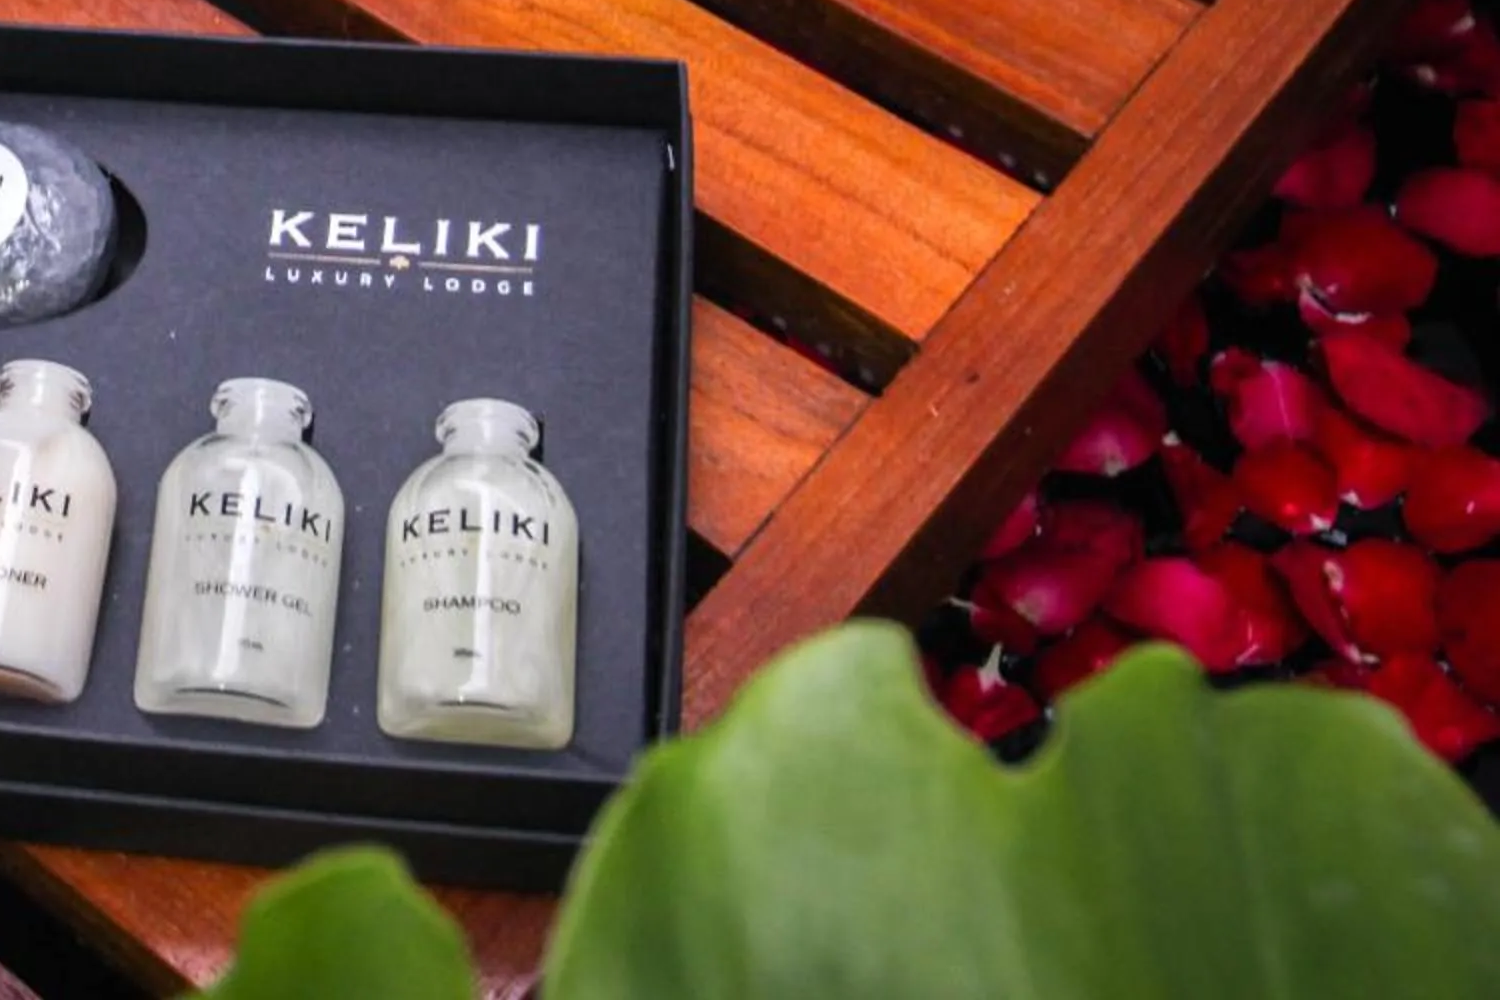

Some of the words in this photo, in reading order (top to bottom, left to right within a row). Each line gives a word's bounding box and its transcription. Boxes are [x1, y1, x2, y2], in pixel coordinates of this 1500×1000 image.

[269, 208, 541, 262] KELIKI
[265, 266, 396, 288] LUXURY
[423, 276, 534, 296] LODGE
[189, 492, 332, 543] KELIKI
[402, 508, 549, 547] KELIKI
[194, 581, 277, 604] SHOWER
[282, 594, 313, 617] GEL
[423, 595, 522, 615] SHAMPOO
